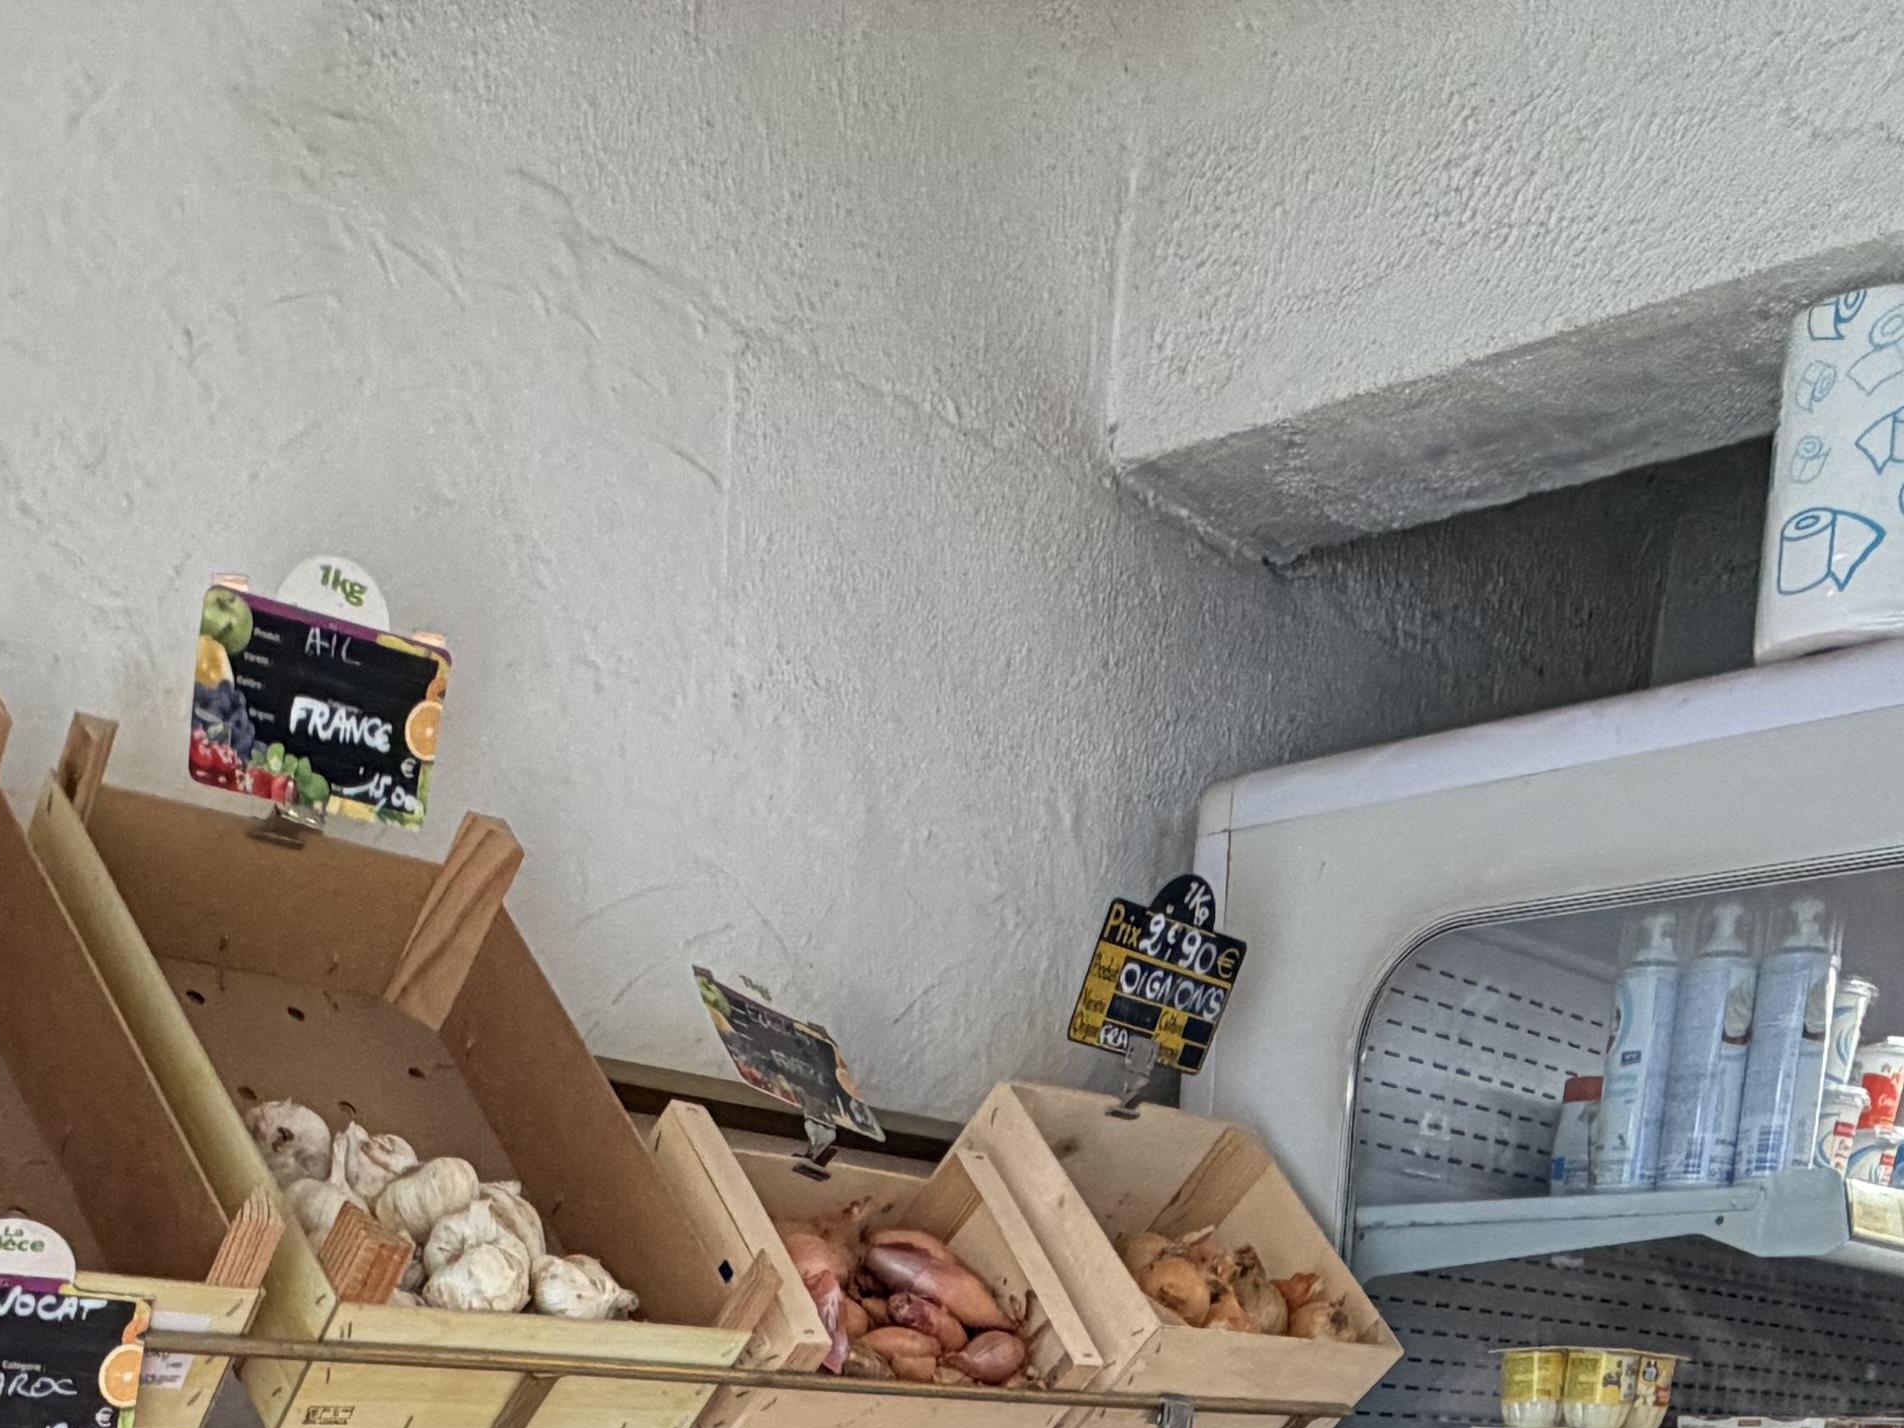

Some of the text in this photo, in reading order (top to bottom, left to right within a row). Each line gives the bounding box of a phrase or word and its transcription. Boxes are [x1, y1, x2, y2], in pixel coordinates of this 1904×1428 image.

[319, 564, 368, 608] 1kg
[305, 627, 362, 667] AIL
[289, 696, 393, 753] FRANCE
[1104, 903, 1141, 948] Prix
[1217, 948, 1240, 979] €
[1120, 961, 1225, 1022] OIGNONS
[4, 1226, 24, 1237] La
[95, 1407, 114, 1428] €
